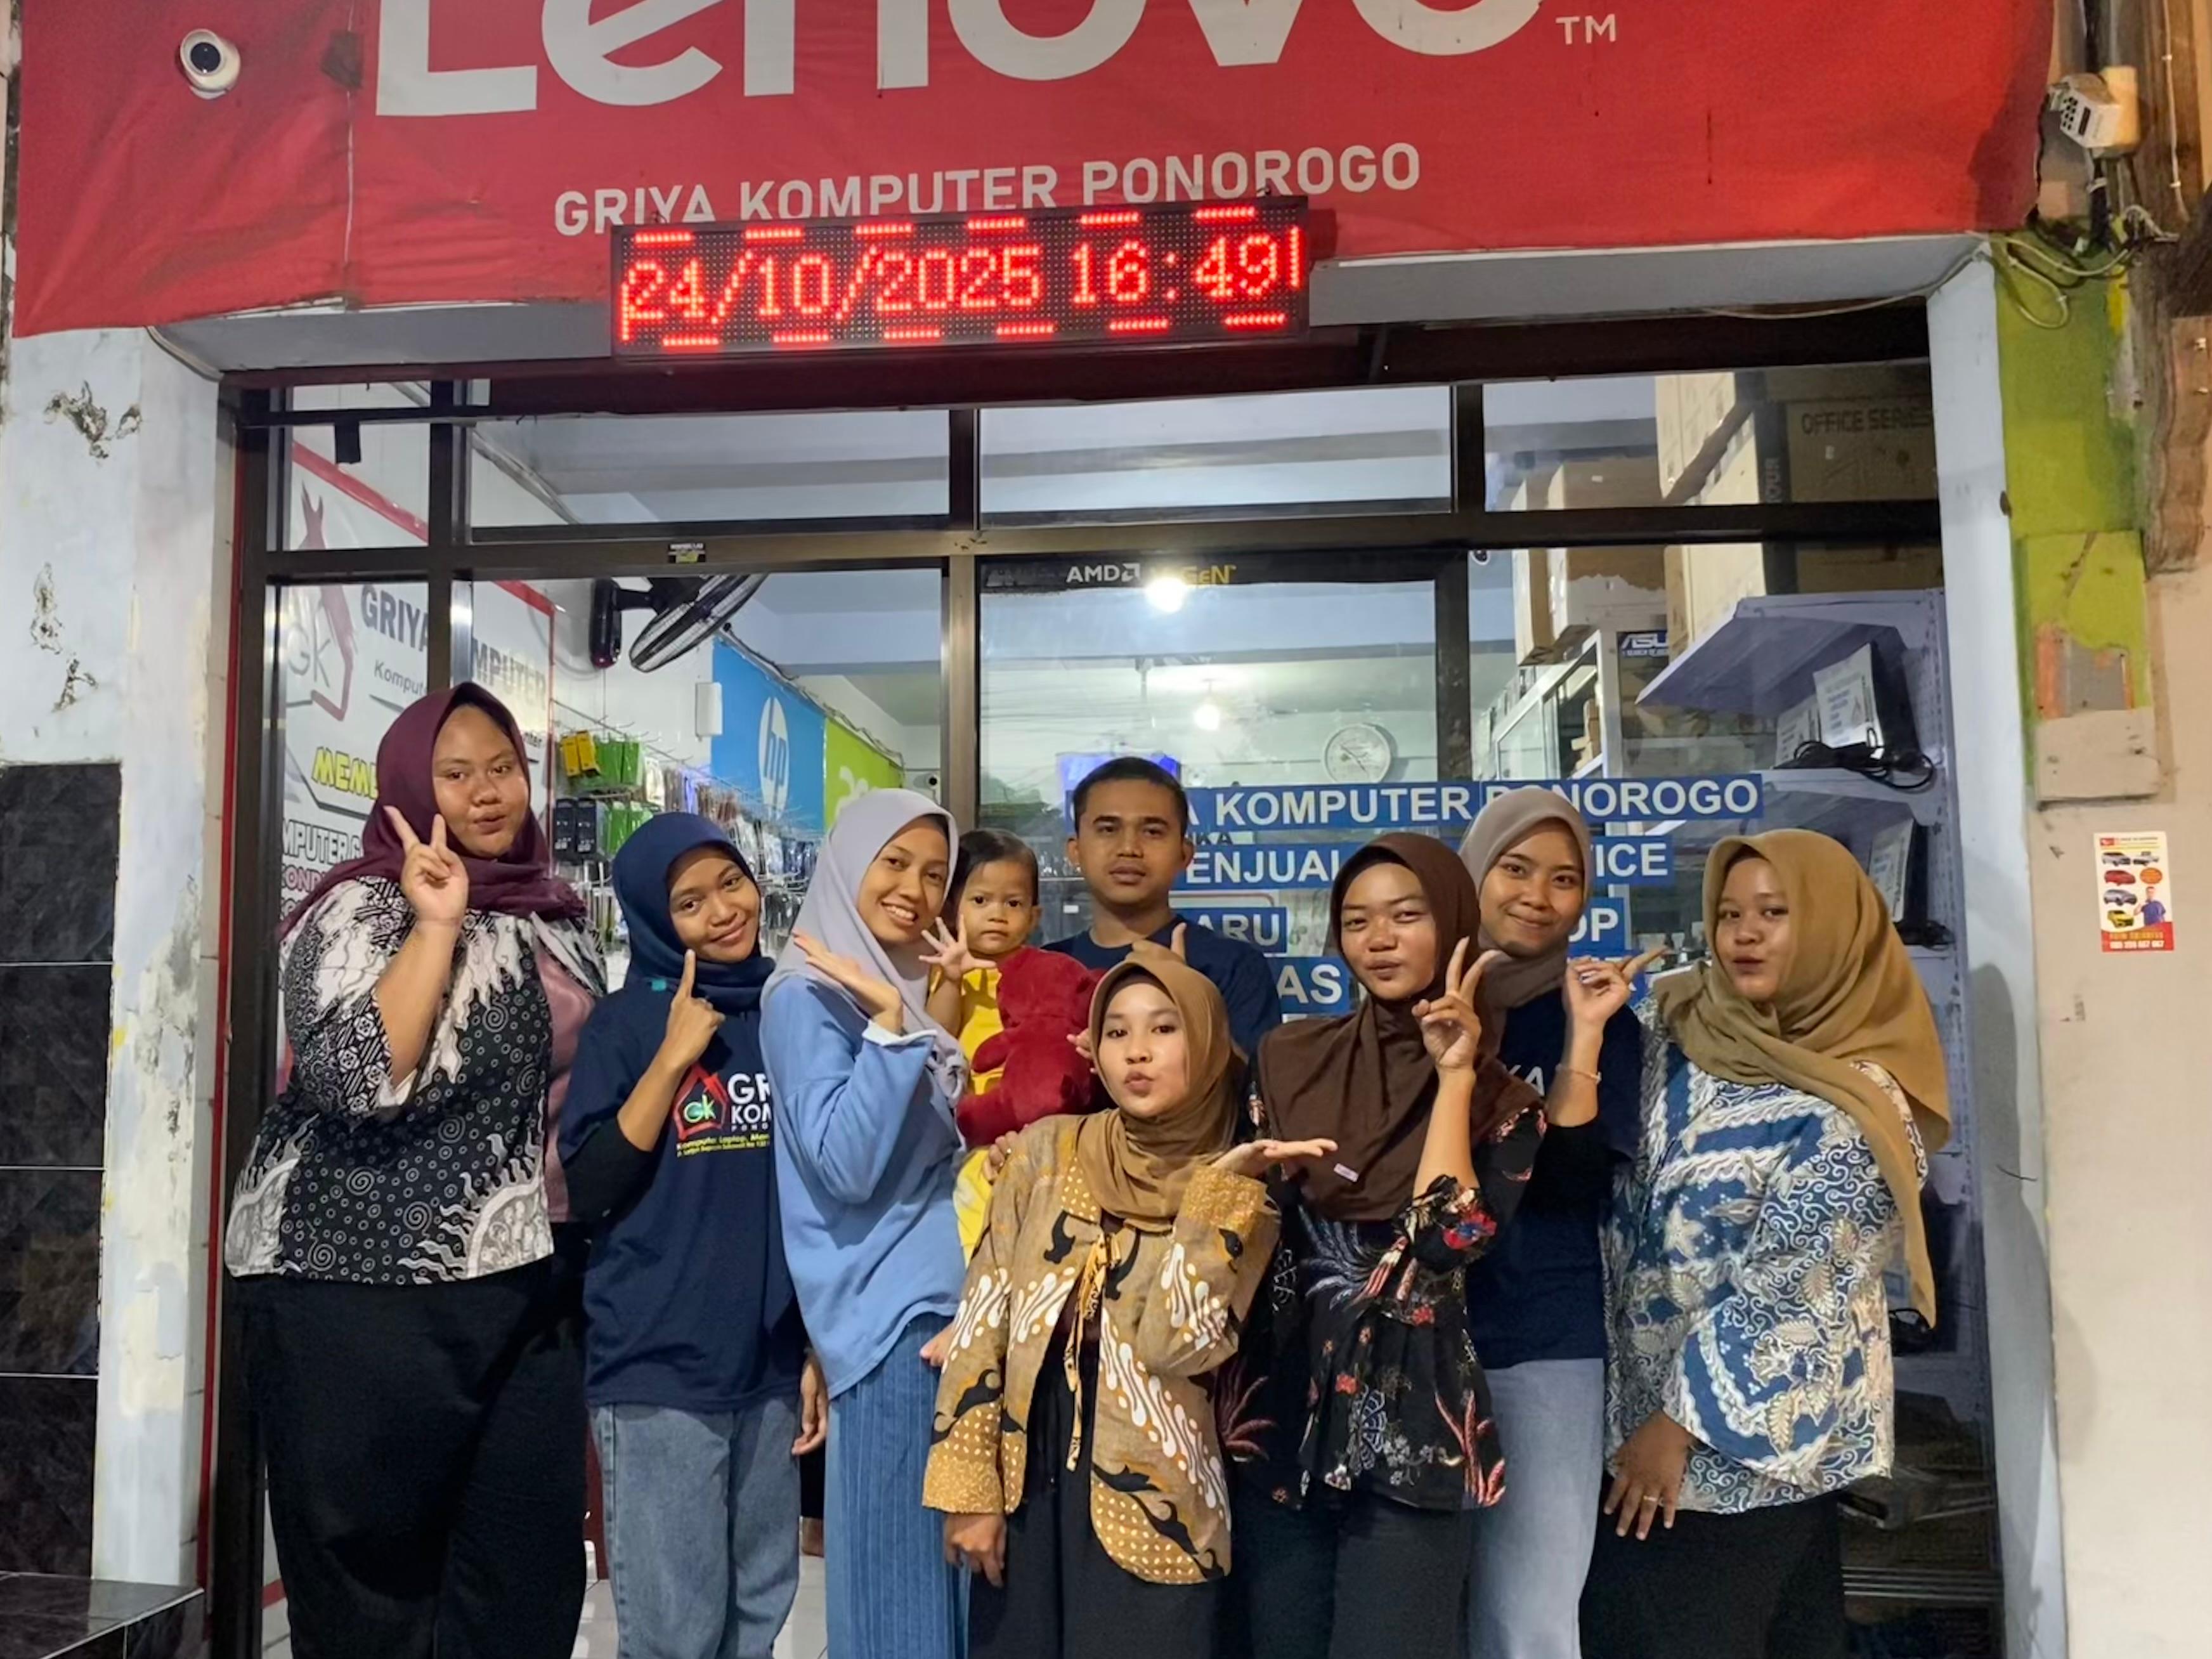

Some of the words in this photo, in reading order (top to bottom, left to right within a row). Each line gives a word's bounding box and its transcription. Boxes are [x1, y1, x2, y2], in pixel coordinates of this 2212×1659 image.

[1556, 14, 1617, 45] TM
[554, 184, 715, 236] GRIYA
[739, 165, 1058, 221] KOMPUTER
[1082, 142, 1420, 205] PONOROGO
[628, 244, 1041, 325] 24/10/2025
[1071, 233, 1278, 306] 16:49
[1800, 409, 1866, 435] OFFICE
[1066, 563, 1121, 583] AMD
[760, 696, 788, 821] hp
[1216, 786, 1472, 825] KOMPUTER
[1486, 779, 1758, 819] NOROGO
